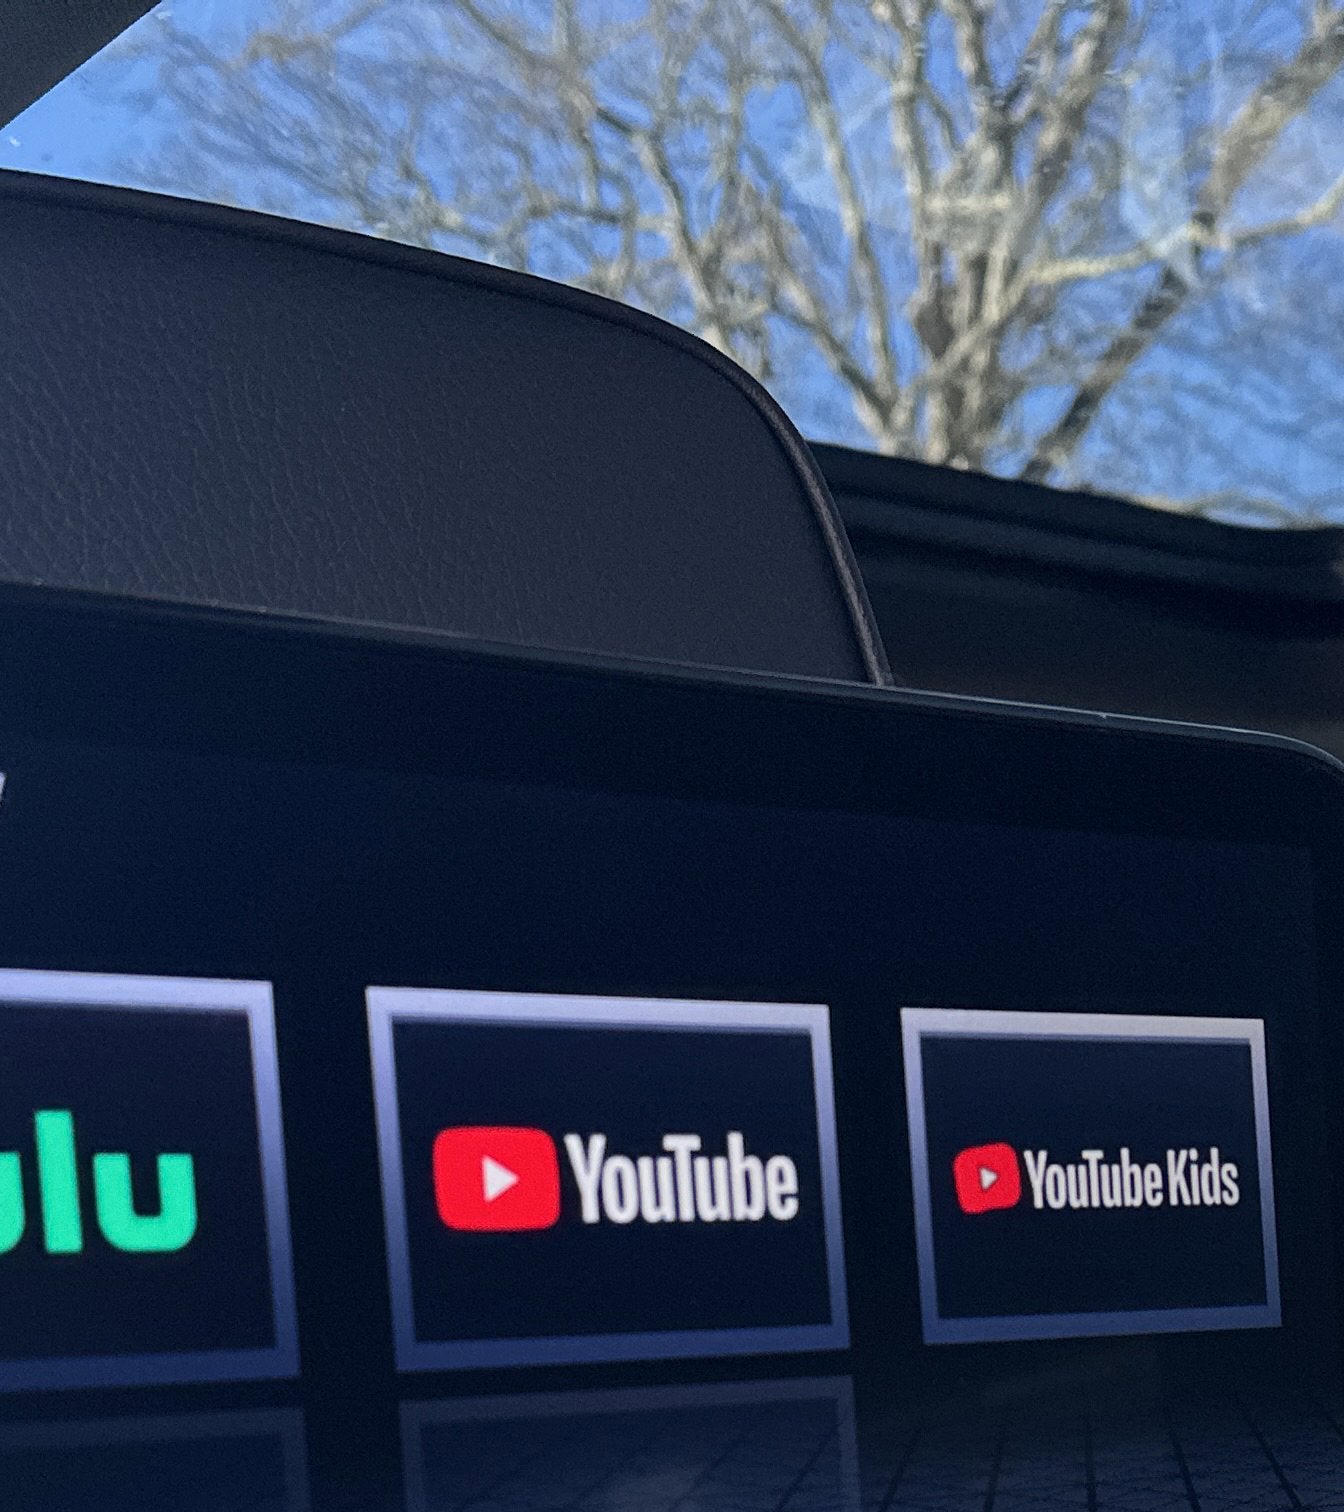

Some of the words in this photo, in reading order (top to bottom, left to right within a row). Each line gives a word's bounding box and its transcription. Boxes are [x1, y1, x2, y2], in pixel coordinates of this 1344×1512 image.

[564, 1131, 799, 1225] YouTube
[1023, 1147, 1163, 1209] YouTube
[1166, 1147, 1240, 1206] Kids
